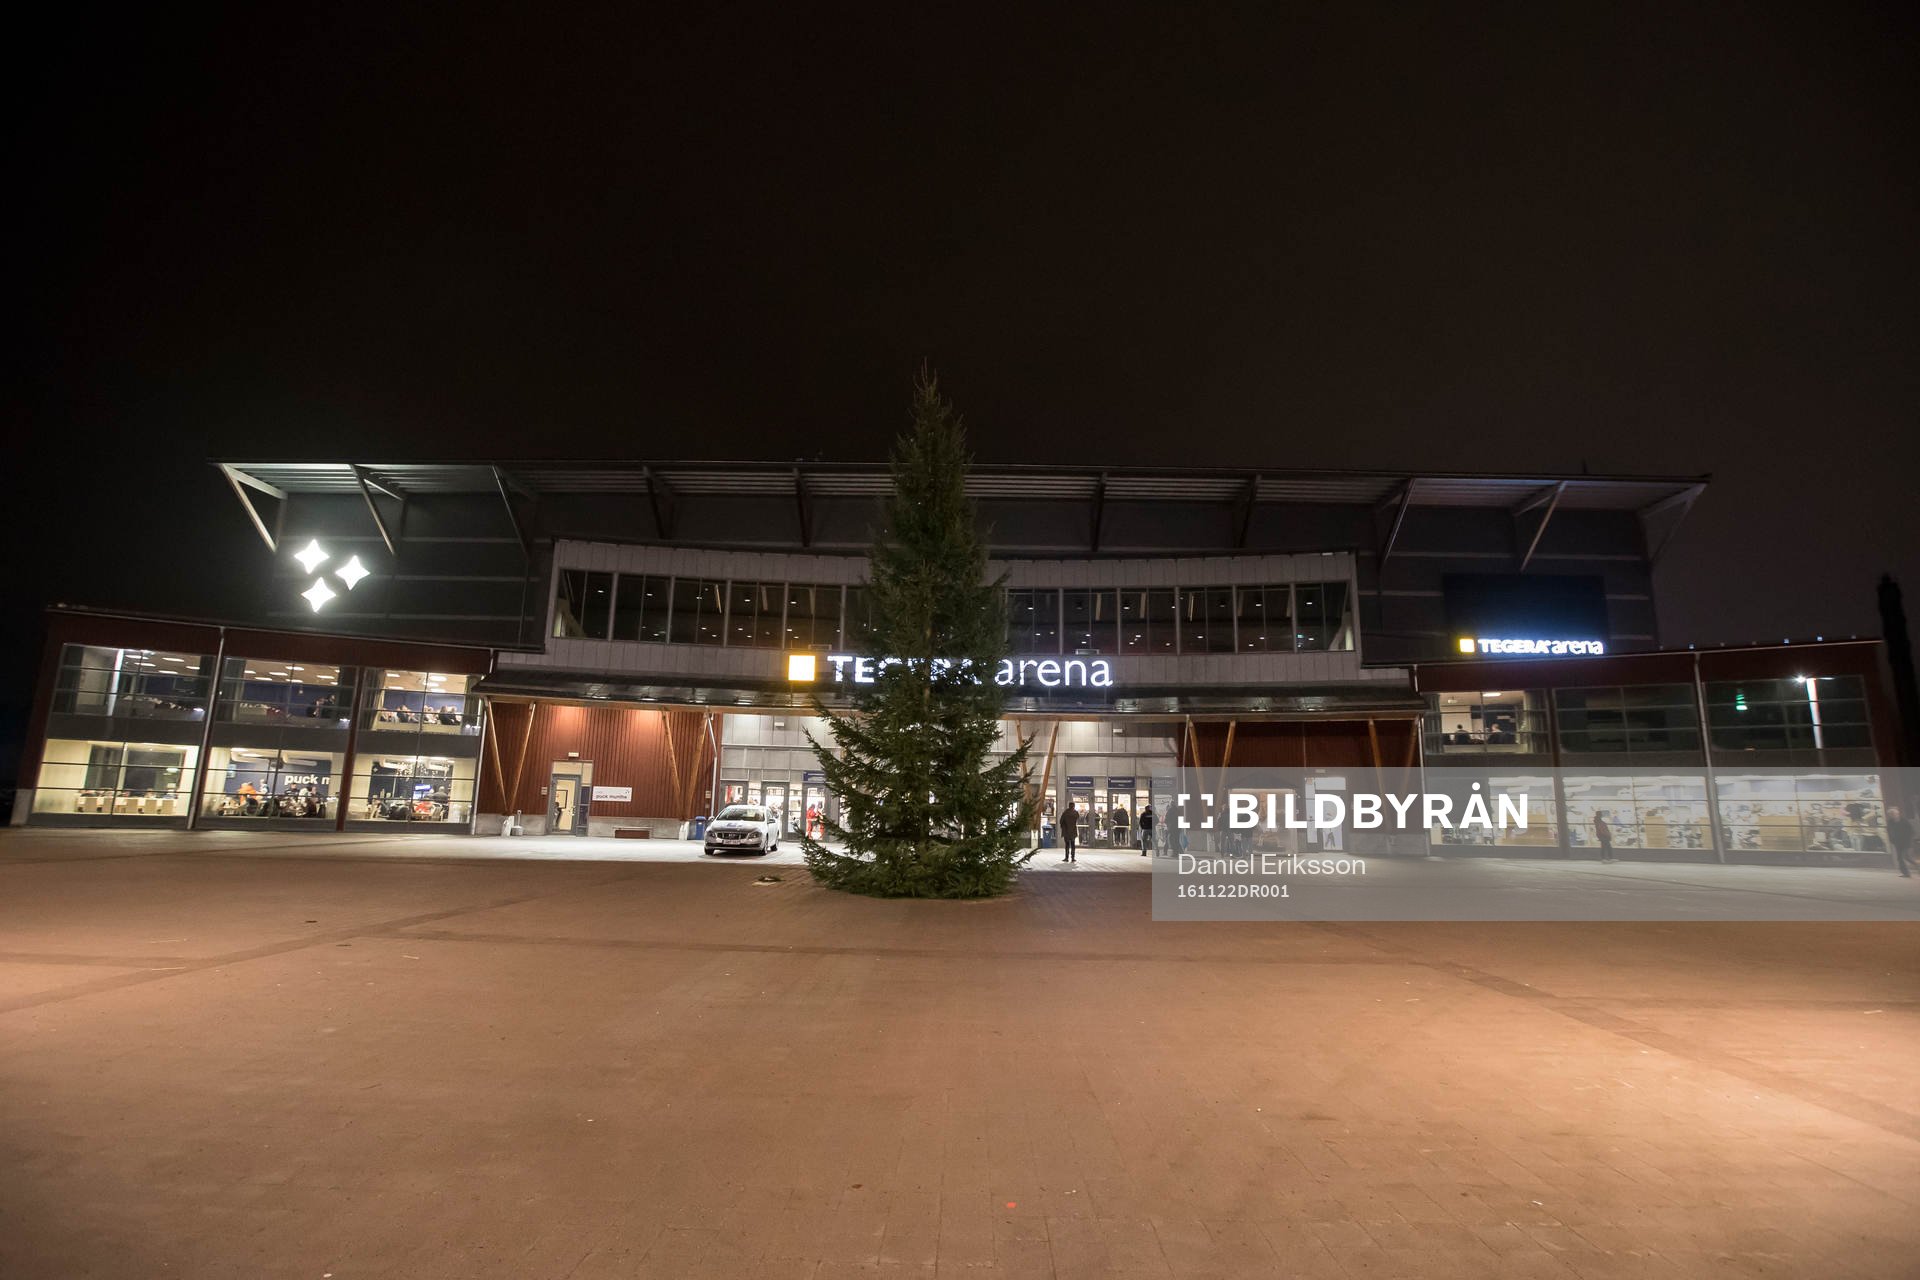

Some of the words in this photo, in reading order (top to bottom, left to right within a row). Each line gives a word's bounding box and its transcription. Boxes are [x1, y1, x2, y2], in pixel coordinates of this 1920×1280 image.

[1551, 640, 1603, 654] arena
[826, 655, 983, 685] TER
[995, 657, 1114, 687] arena
[284, 774, 319, 785] puck
